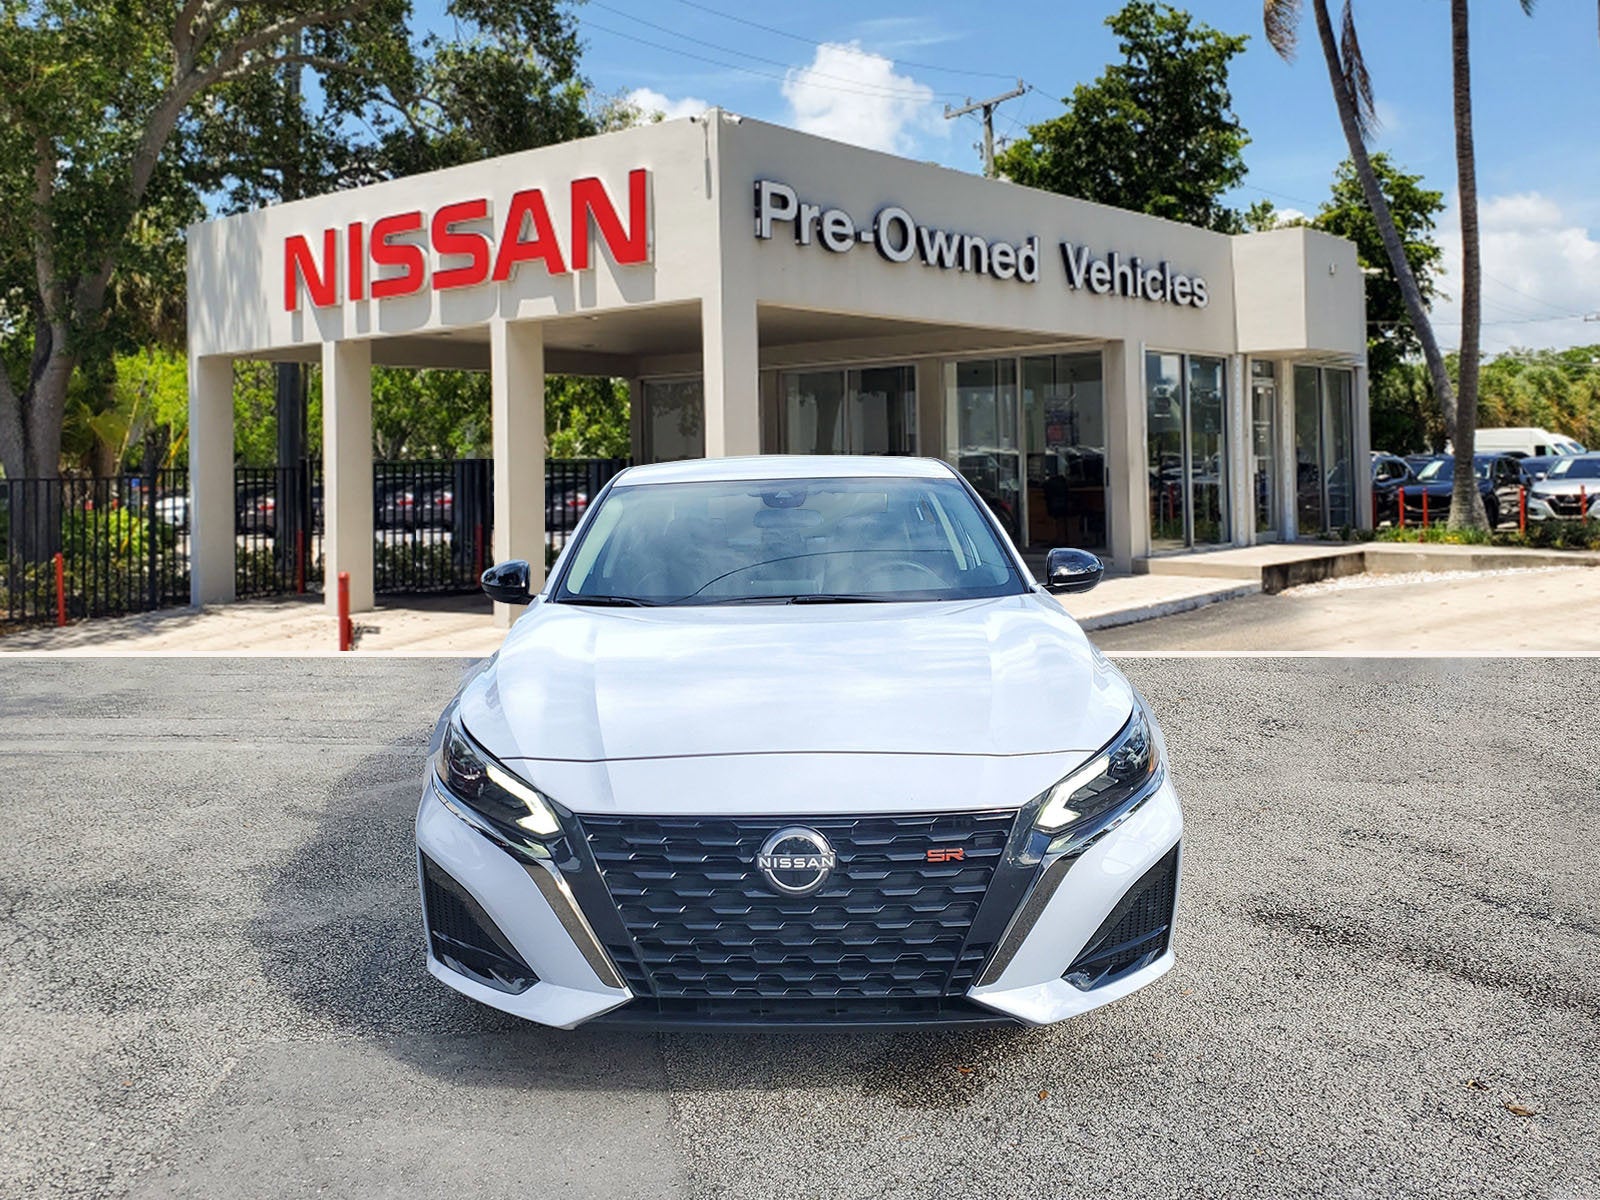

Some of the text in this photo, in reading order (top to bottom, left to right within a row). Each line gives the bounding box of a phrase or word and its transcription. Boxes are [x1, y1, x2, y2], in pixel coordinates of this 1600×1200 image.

[284, 168, 648, 312] NISSAN
[754, 179, 1208, 309] Pre-Owned Vehicles
[758, 855, 835, 869] NISSAN
[926, 847, 964, 862] SR
